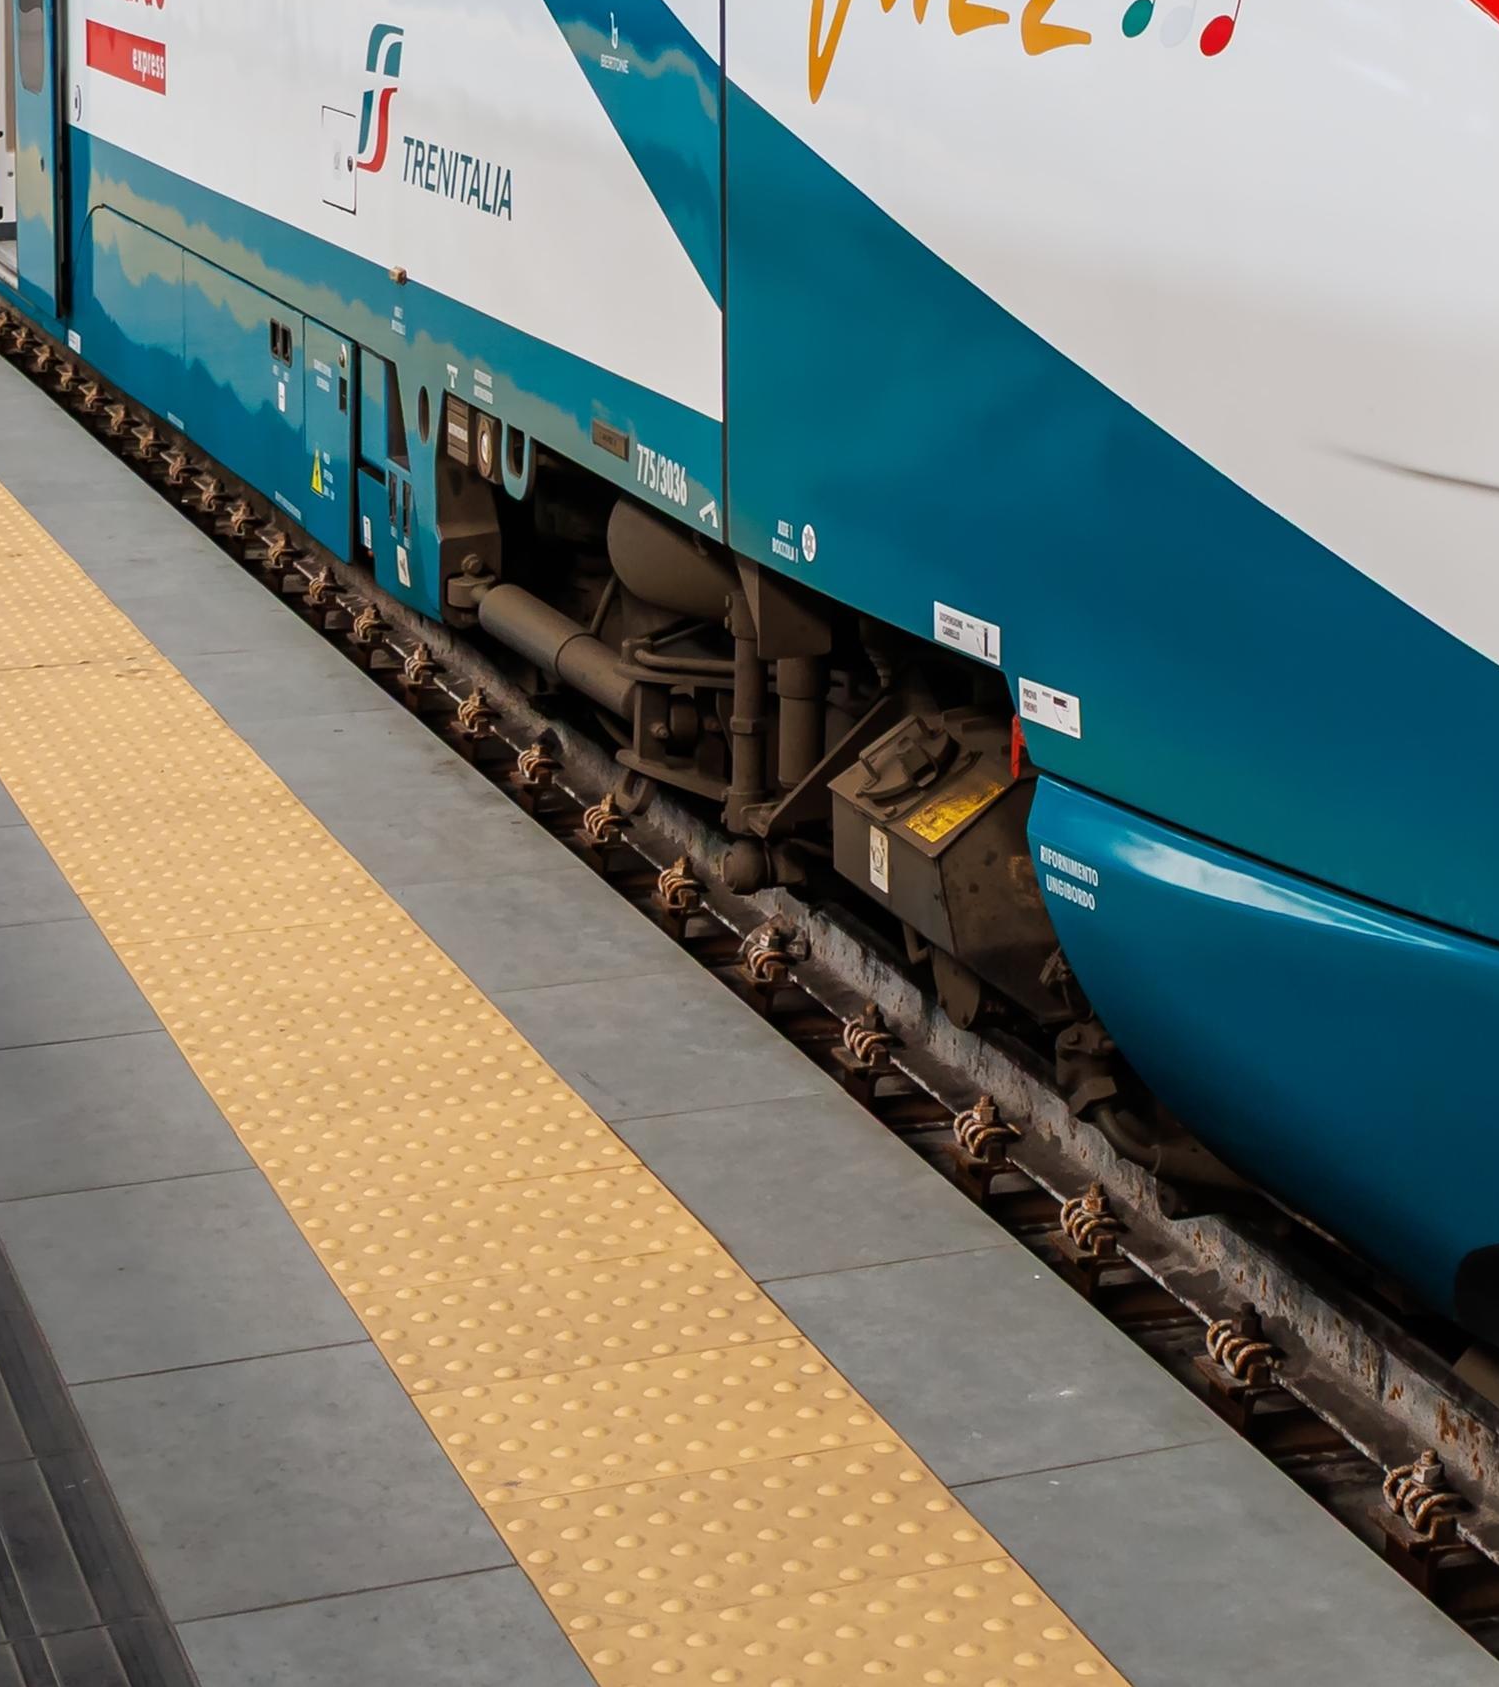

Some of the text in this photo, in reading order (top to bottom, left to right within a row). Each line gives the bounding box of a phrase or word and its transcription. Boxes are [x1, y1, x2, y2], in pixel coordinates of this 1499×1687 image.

[133, 48, 165, 82] express
[403, 135, 512, 221] TRENITALIA
[1039, 844, 1099, 888] RIFORNIMENTO
[1045, 873, 1096, 912] UNGIBORDO
